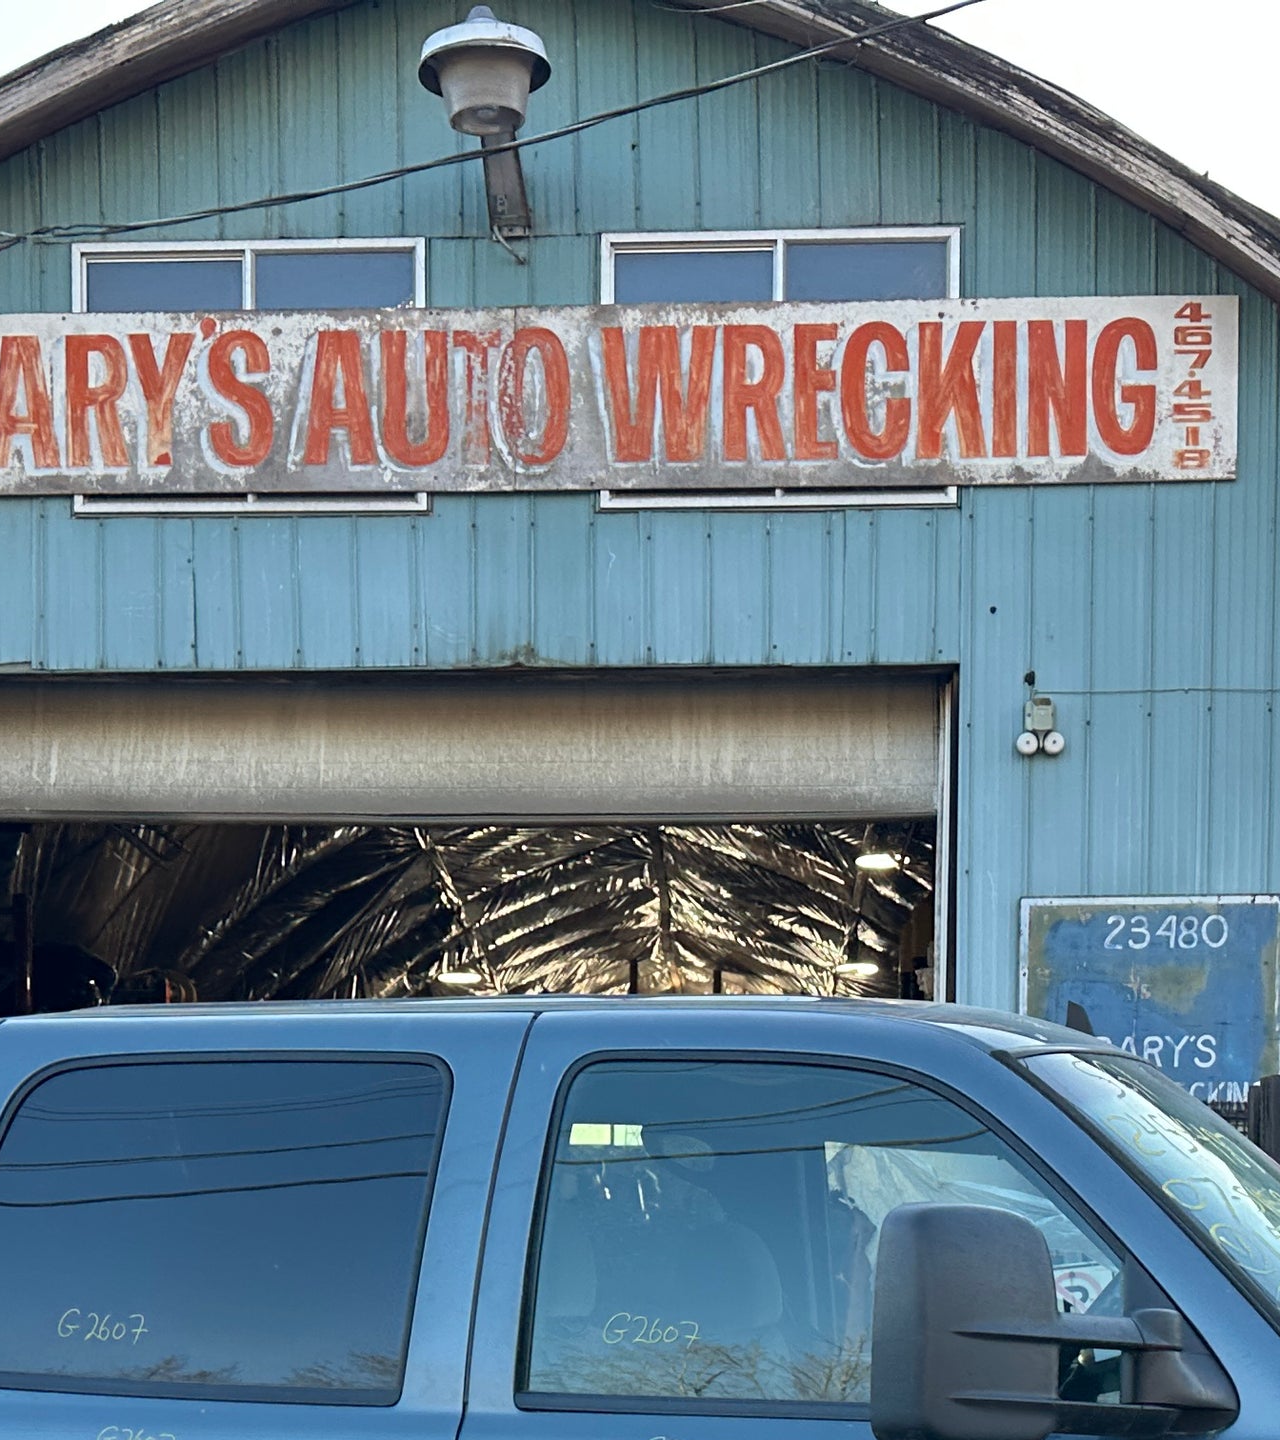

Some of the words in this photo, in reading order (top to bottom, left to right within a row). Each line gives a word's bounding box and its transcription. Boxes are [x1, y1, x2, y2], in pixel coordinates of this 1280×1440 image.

[304, 326, 571, 467] AUTO
[600, 317, 1158, 463] WRECKING
[1103, 914, 1229, 951] 23480
[1096, 1034, 1218, 1069] ARY'S
[57, 1308, 149, 1345] G2607
[602, 1312, 701, 1346] G2607
